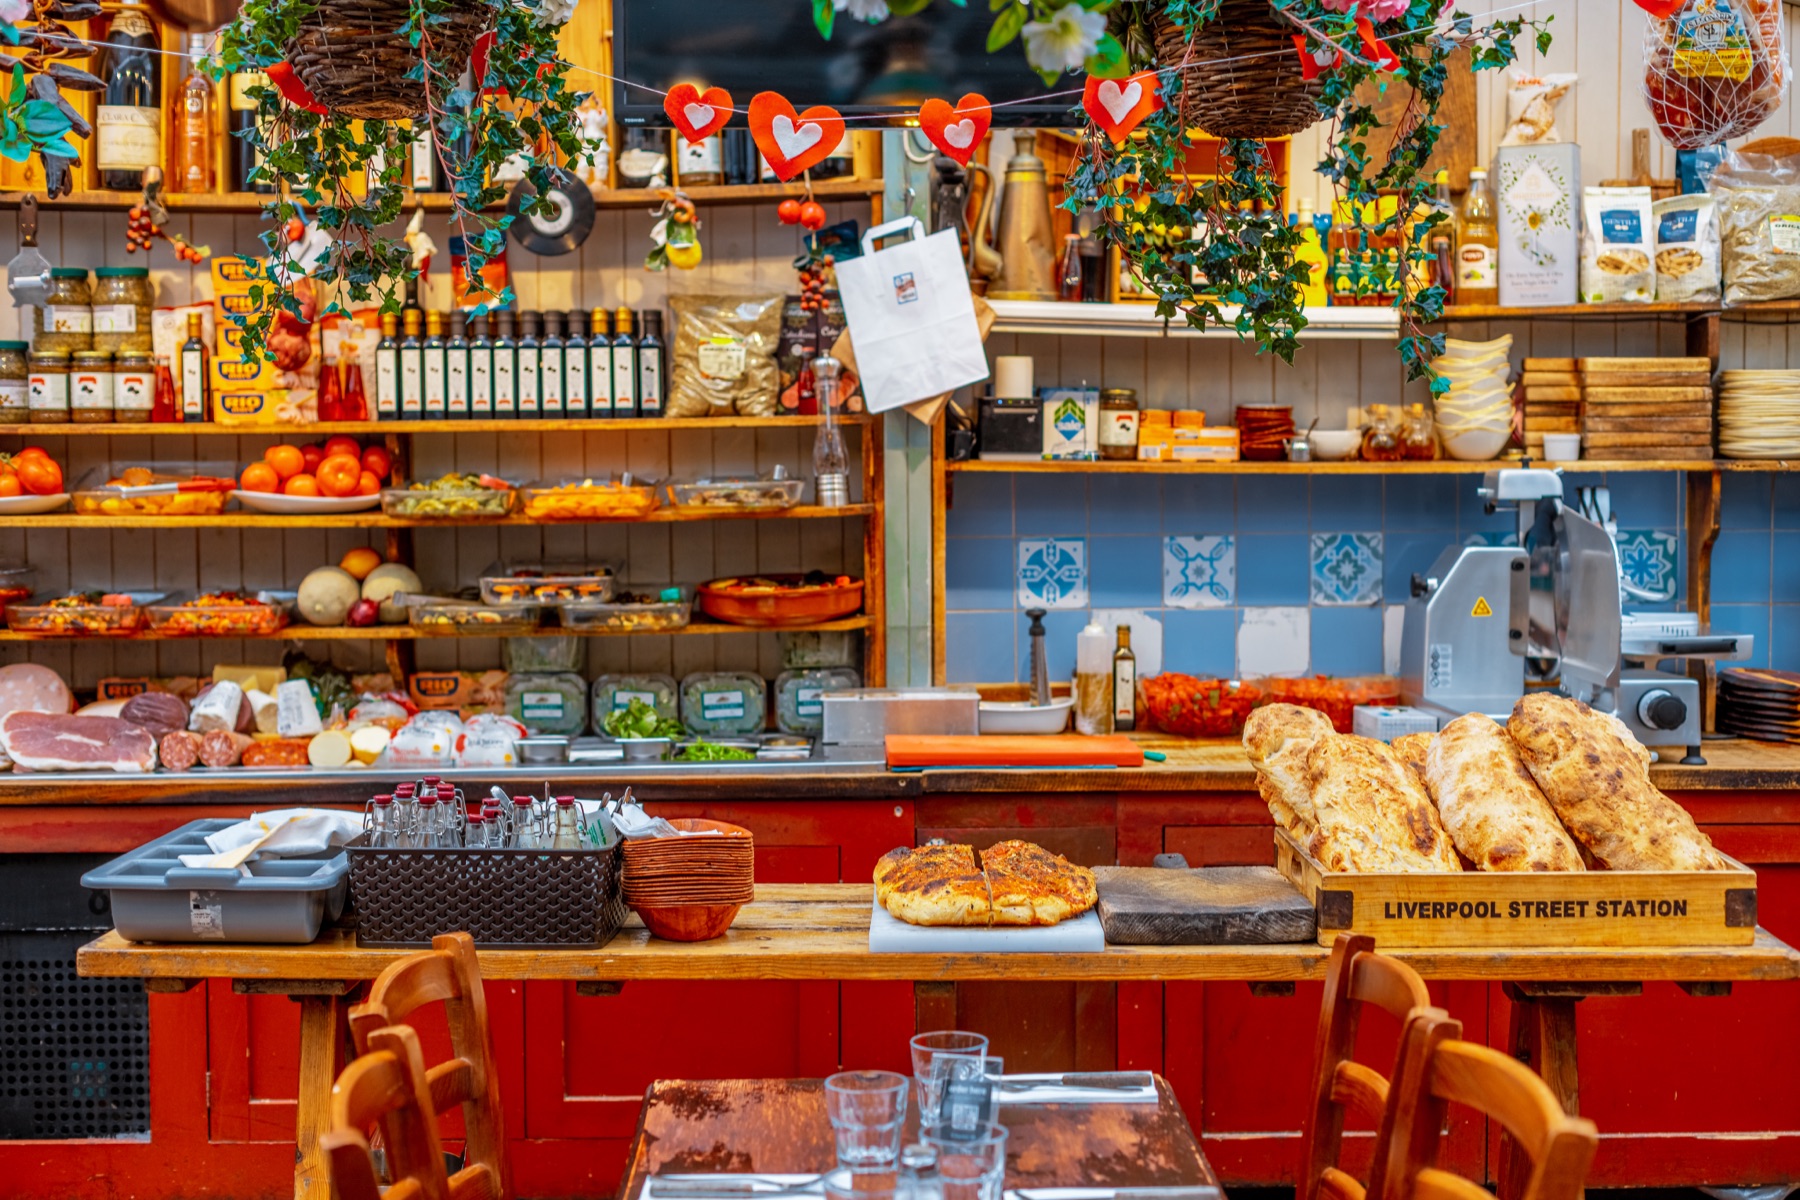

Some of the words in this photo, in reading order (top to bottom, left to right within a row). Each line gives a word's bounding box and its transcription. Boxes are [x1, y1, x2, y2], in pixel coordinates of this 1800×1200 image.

[1603, 218, 1639, 226] GENTILE
[221, 363, 259, 375] RIO
[224, 396, 261, 409] RIO
[420, 679, 456, 690] RIO
[108, 685, 143, 696] RIO
[1384, 902, 1501, 919] LIVERPOOL
[1508, 901, 1588, 918] STREET
[1595, 900, 1688, 917] STATION
